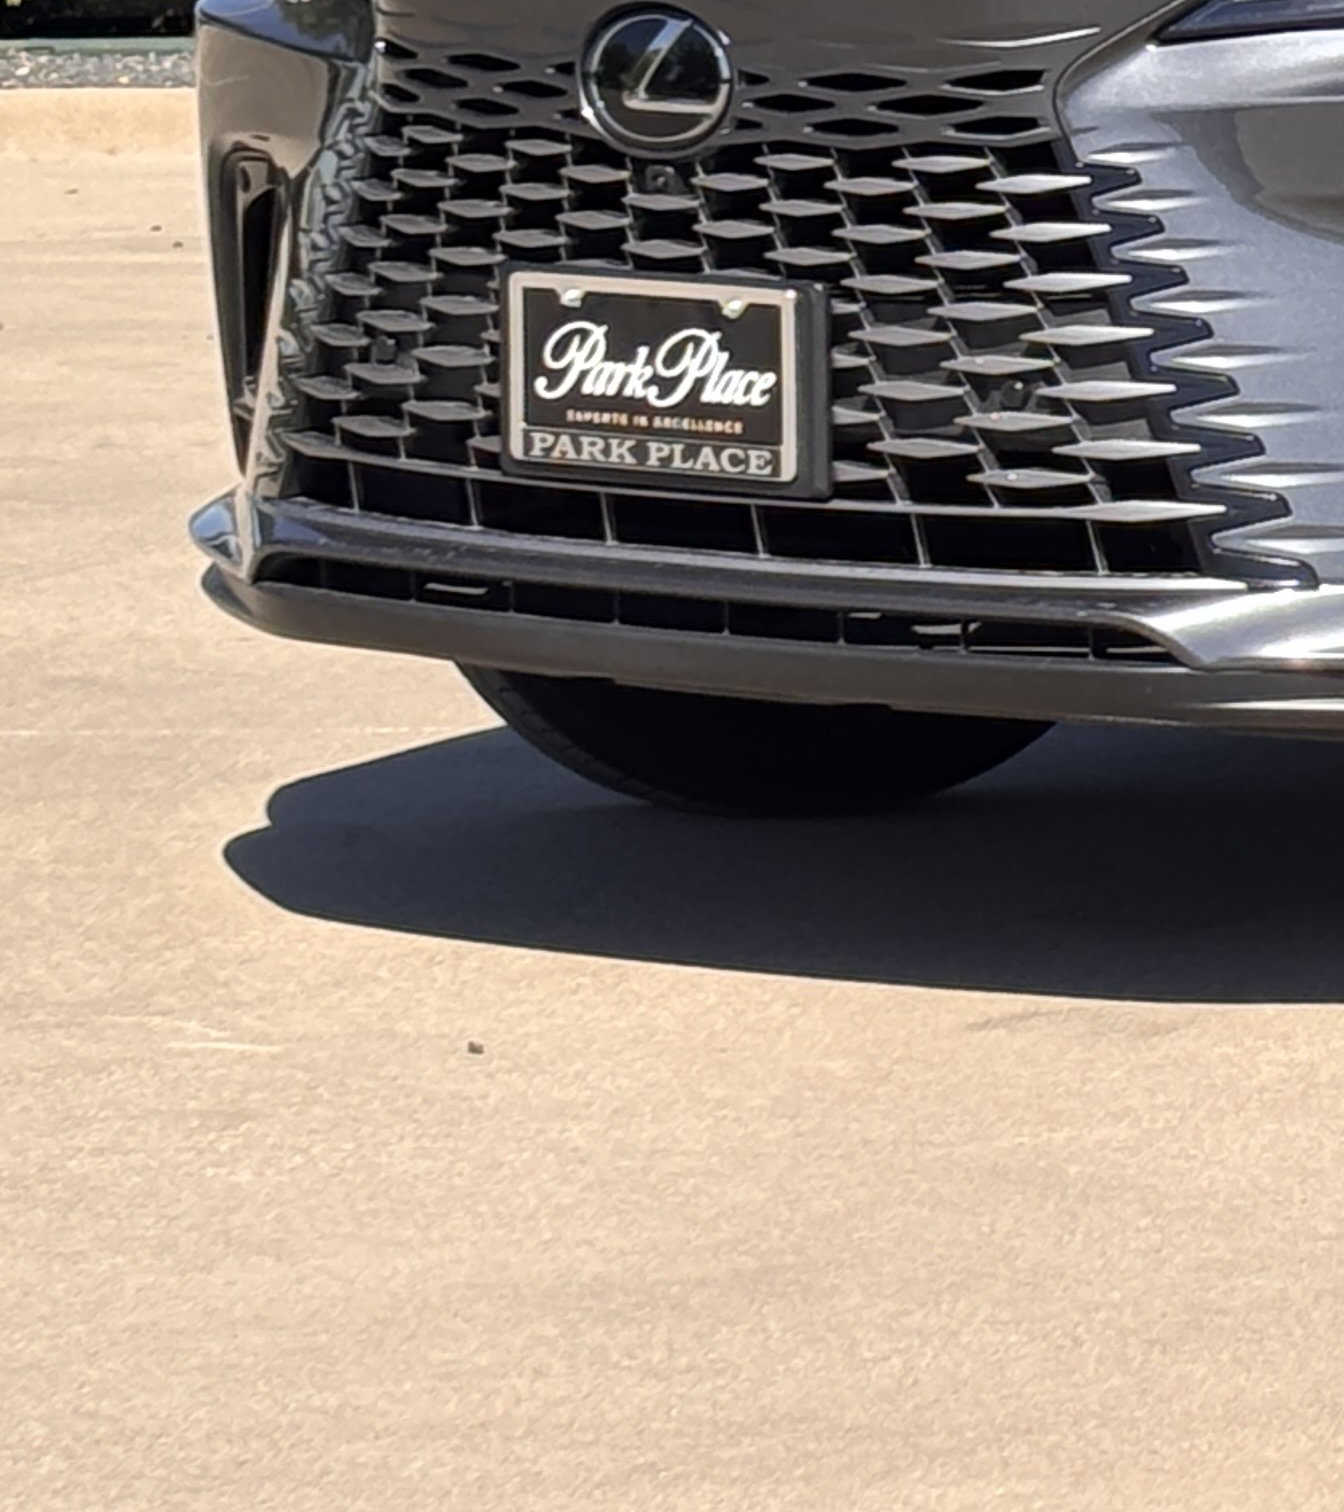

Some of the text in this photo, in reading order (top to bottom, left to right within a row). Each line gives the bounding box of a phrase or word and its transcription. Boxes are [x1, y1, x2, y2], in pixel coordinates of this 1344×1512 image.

[534, 320, 778, 408] Park Place
[566, 408, 628, 426] EXPERTS
[632, 412, 649, 429] IN
[528, 431, 774, 476] PARK PLACE
